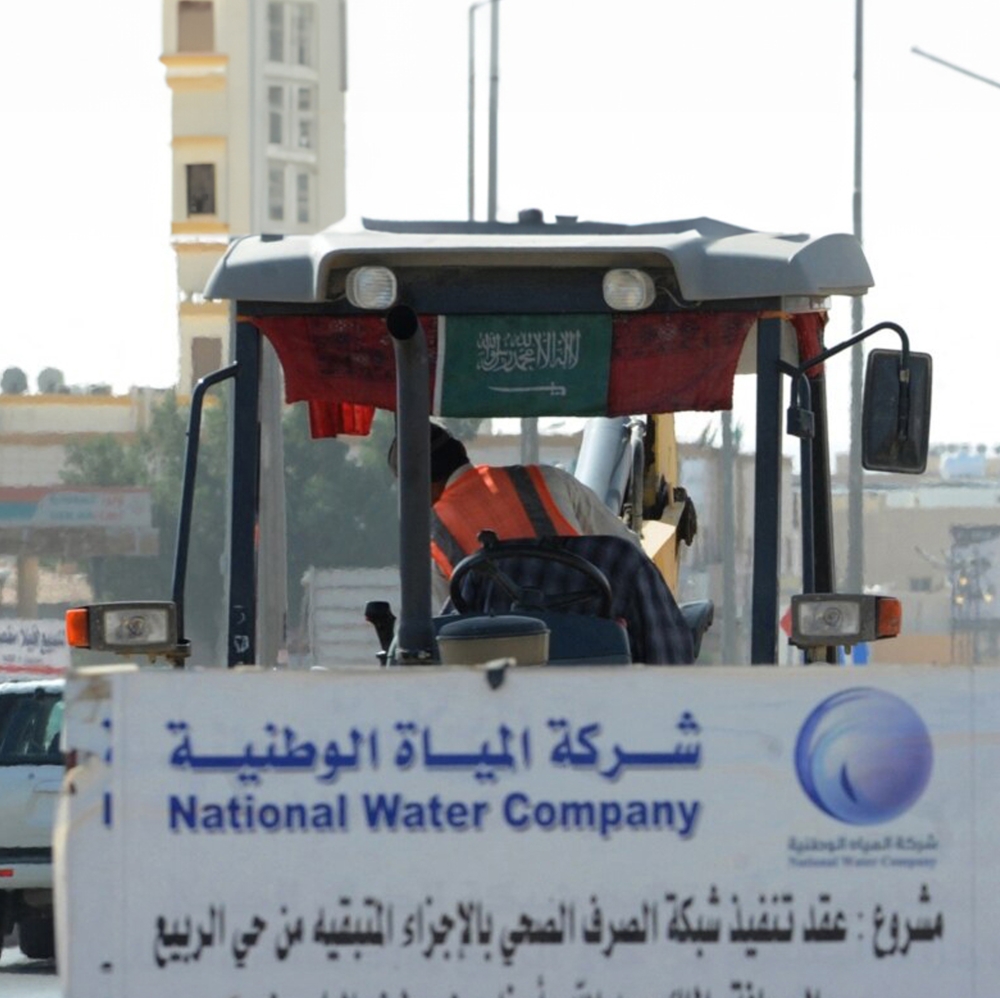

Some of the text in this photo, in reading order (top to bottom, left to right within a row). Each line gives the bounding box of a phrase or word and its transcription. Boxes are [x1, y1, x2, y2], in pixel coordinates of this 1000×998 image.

[546, 711, 702, 784] شركة
[168, 791, 702, 841] National Water Company
[154, 906, 224, 969] الربيع
[231, 915, 267, 969] حي
[274, 906, 305, 962] من
[499, 903, 575, 967] الصحي
[582, 896, 658, 958] الصرف
[664, 885, 721, 958] شبكة
[728, 893, 795, 958] تنفيذ
[802, 893, 848, 944] عقد
[872, 885, 945, 960] مشروع
